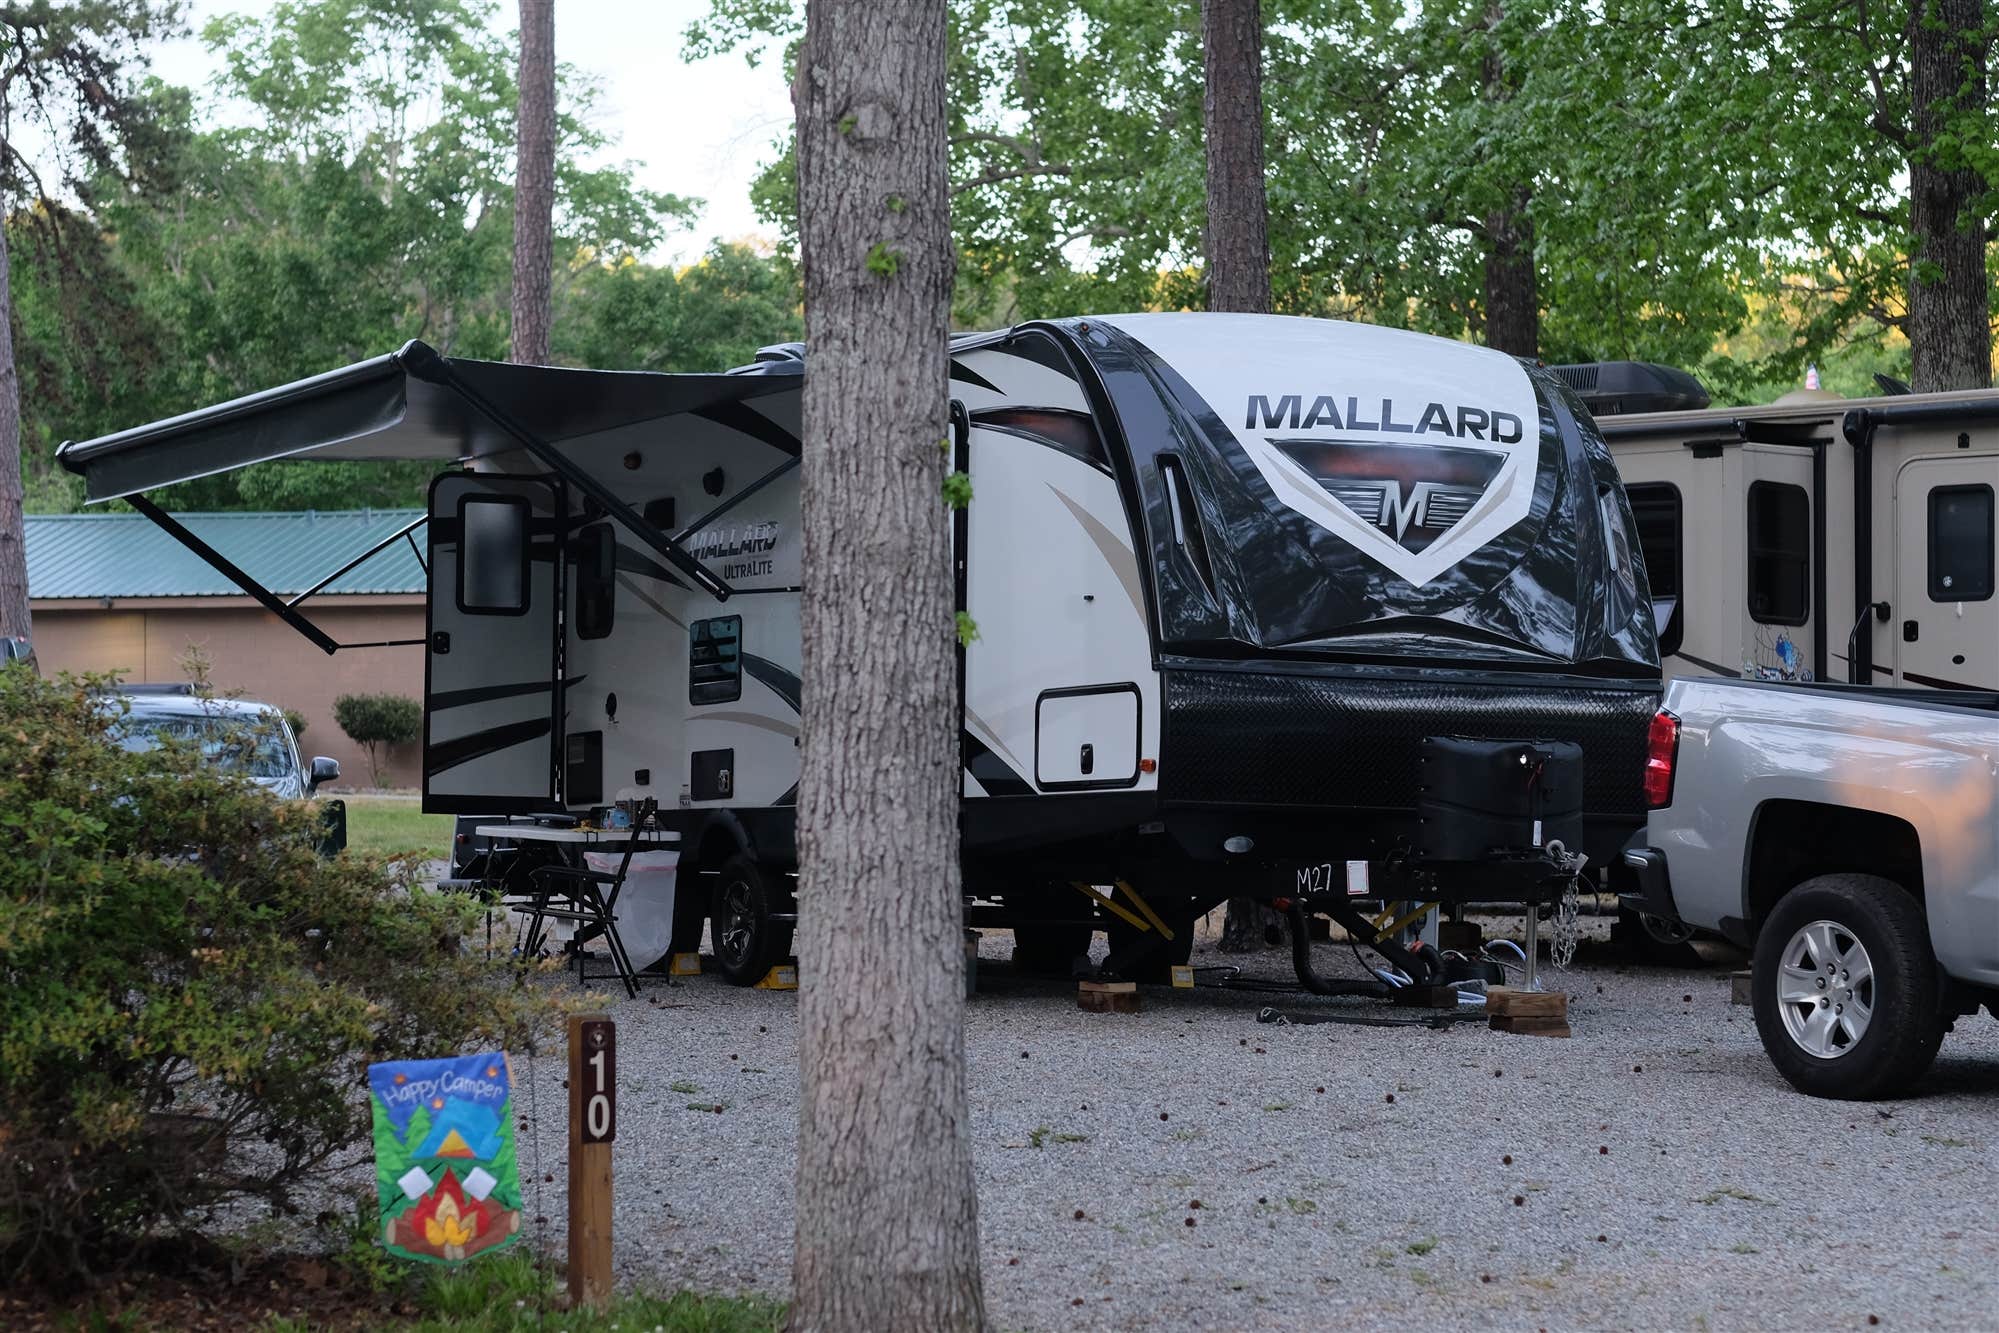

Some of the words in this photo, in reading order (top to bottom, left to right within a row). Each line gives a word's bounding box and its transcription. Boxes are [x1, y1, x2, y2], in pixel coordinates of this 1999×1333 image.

[1245, 394, 1523, 444] MALLARD
[1379, 479, 1432, 545] M
[689, 520, 778, 560] MALLARD
[1297, 863, 1332, 894] M27
[382, 1079, 441, 1107] Happy
[440, 1070, 503, 1102] Camper
[587, 1050, 610, 1139] 10
